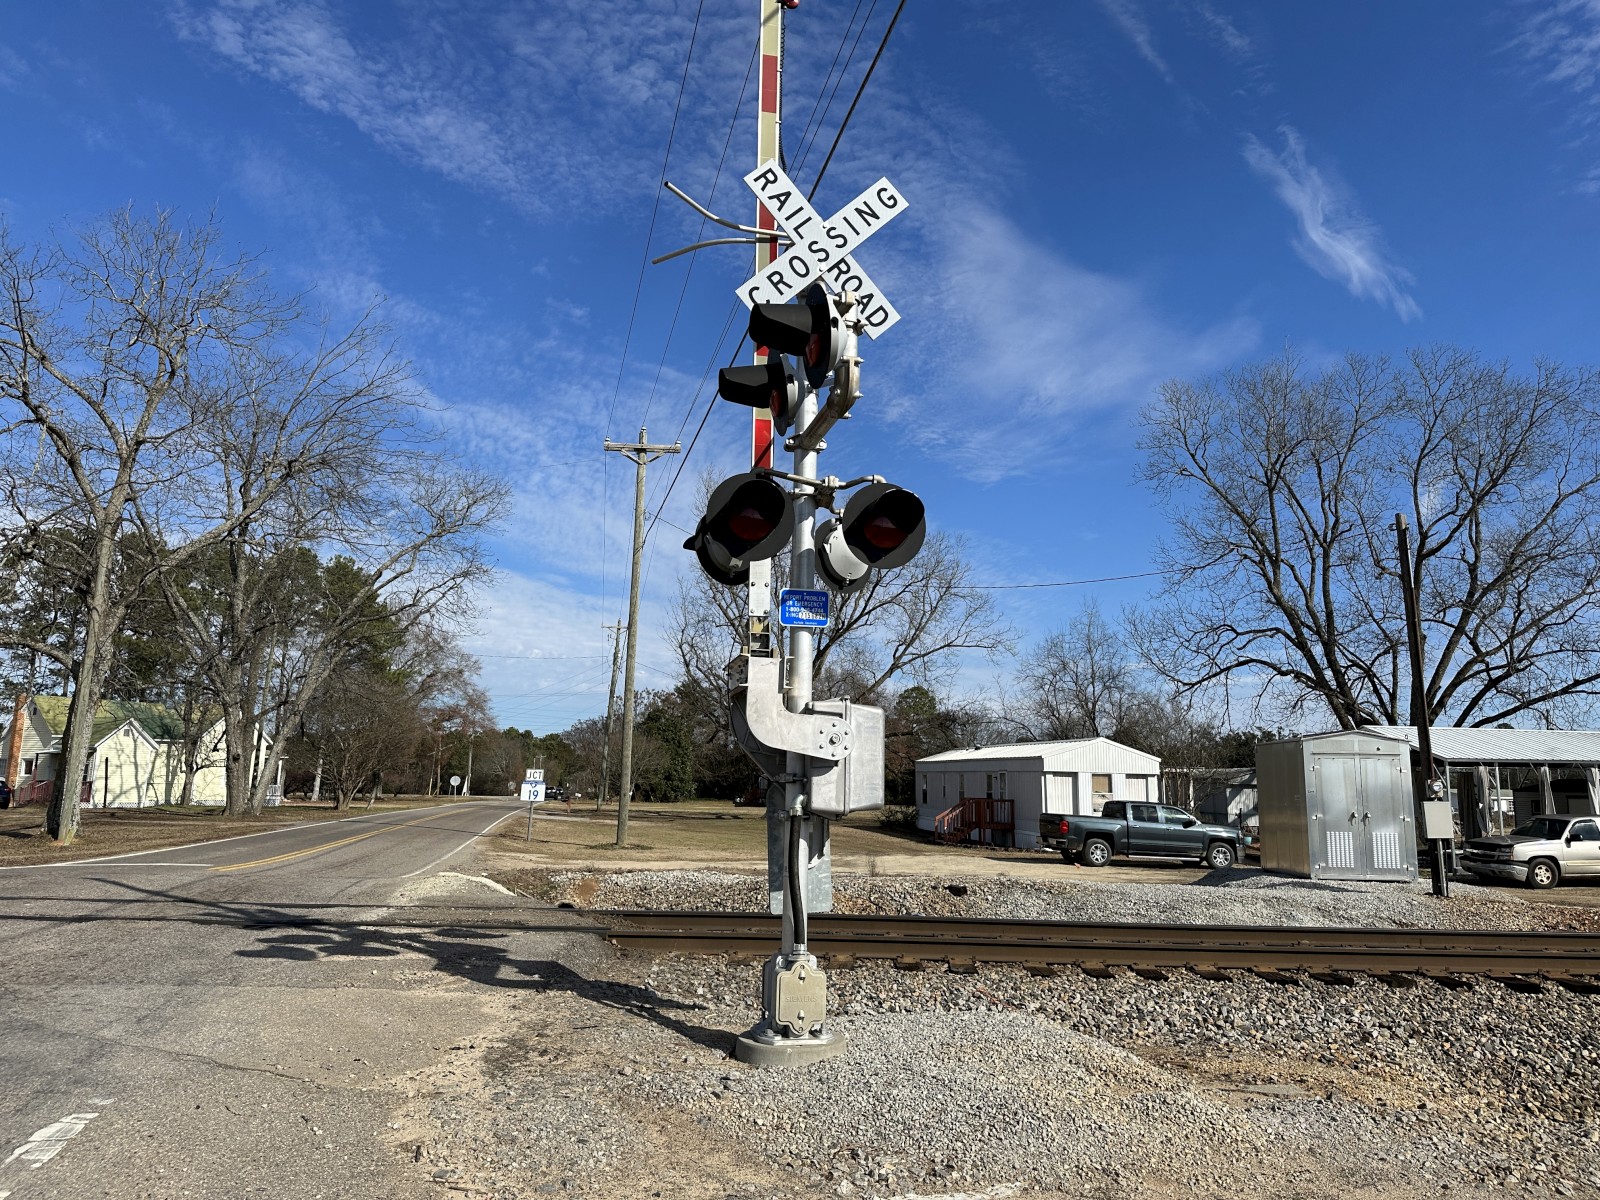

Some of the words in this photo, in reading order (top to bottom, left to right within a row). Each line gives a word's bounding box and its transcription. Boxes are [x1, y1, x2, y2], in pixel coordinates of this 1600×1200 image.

[748, 187, 898, 305] CROSSING
[753, 167, 813, 240] RAIL
[827, 257, 889, 328] ROAD
[527, 770, 542, 780] JCT
[528, 789, 539, 801] 19
